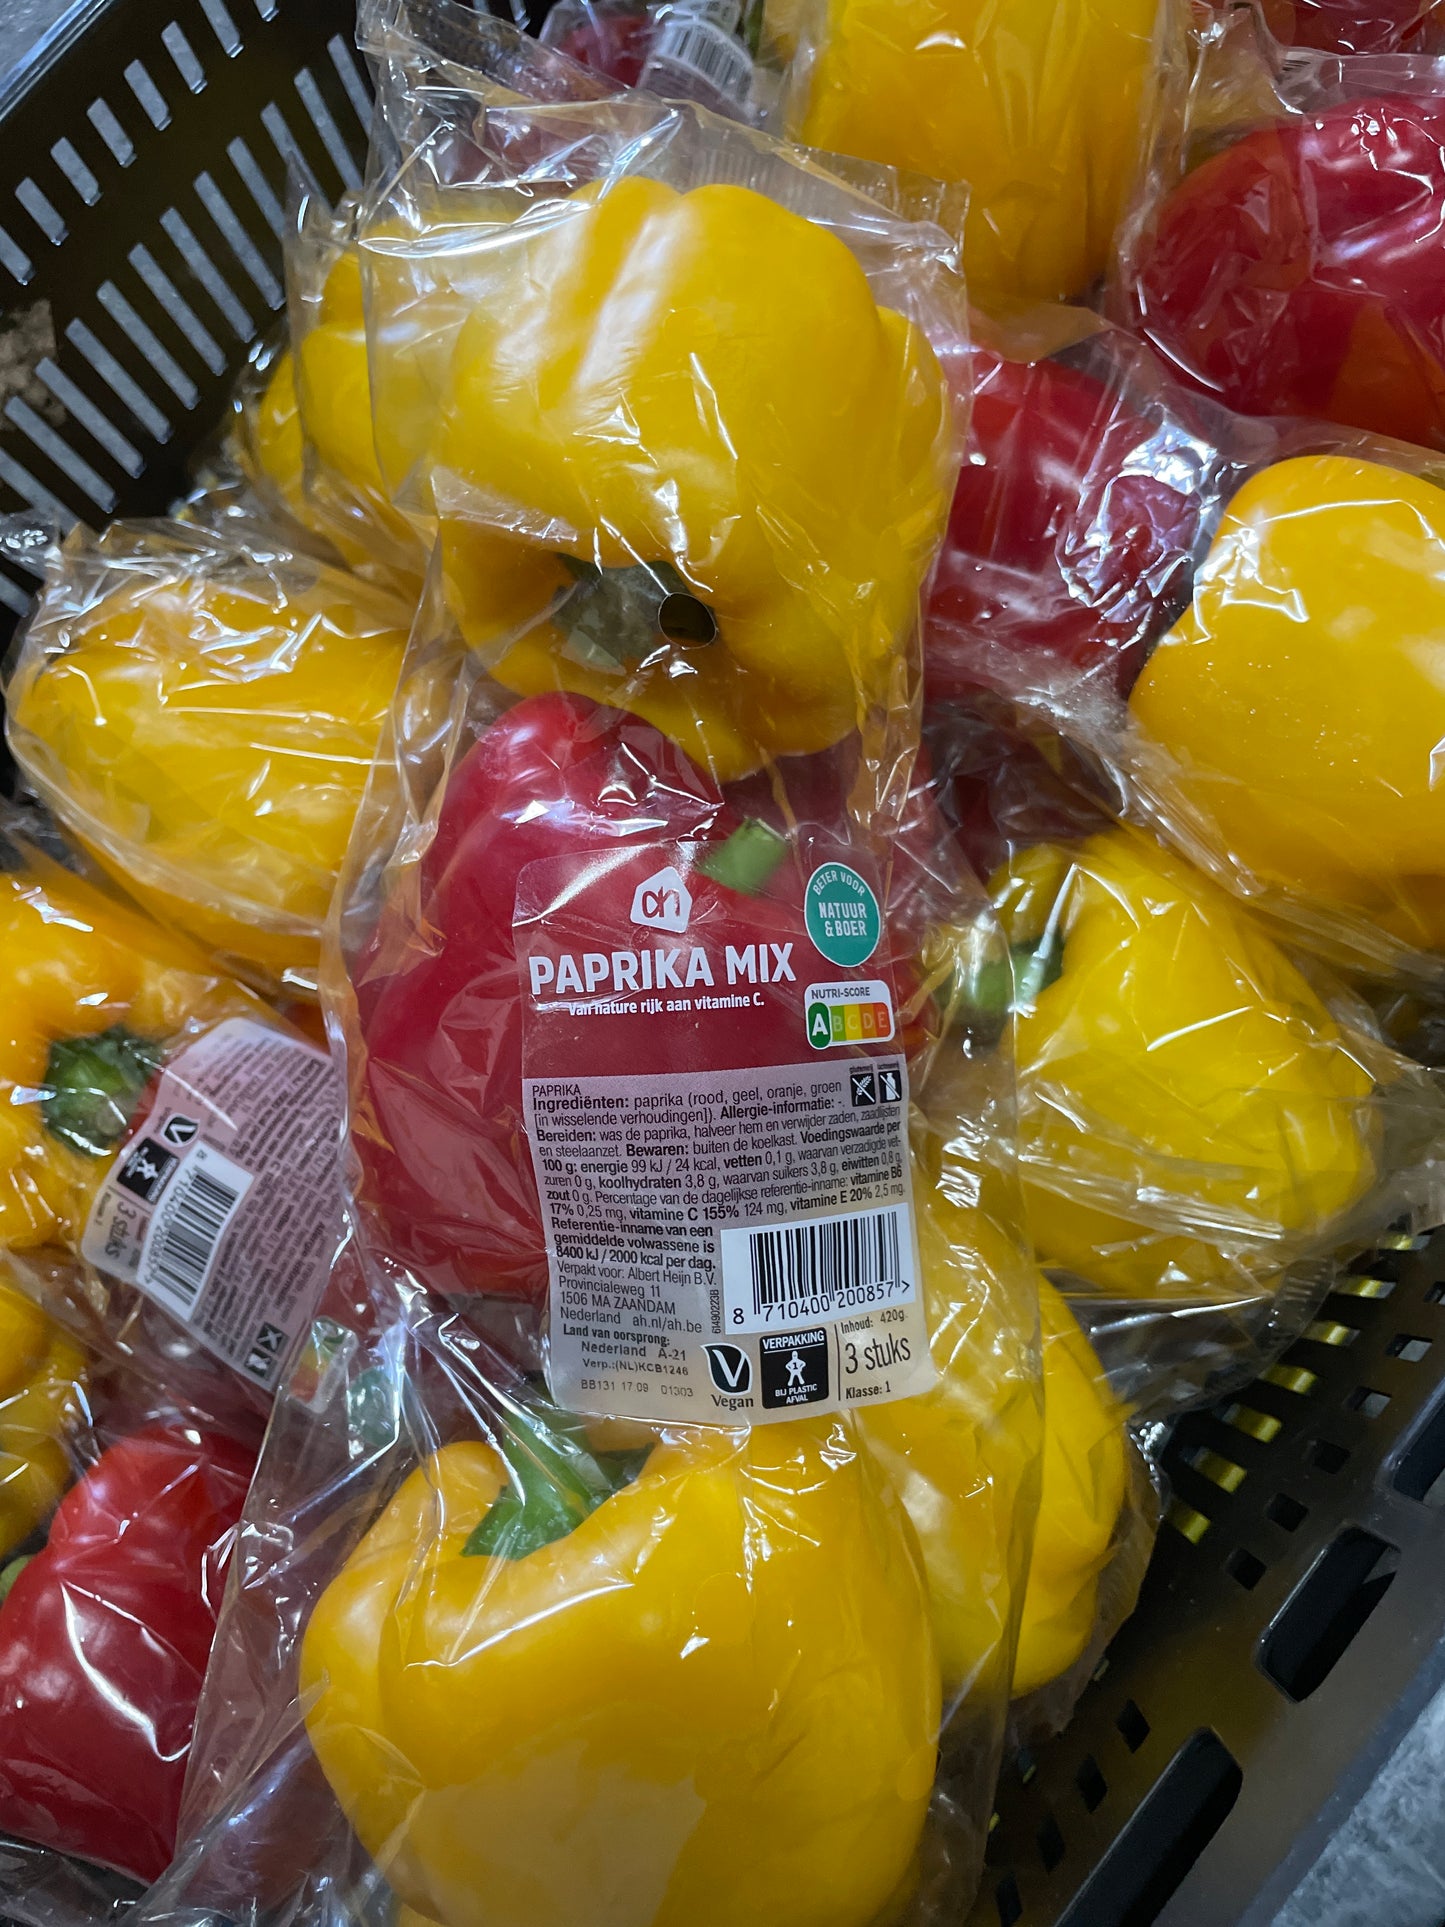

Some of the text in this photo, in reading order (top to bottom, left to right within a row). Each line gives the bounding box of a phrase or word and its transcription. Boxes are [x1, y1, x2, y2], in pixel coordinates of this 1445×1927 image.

[813, 870, 866, 897] BETER VOOR
[819, 902, 867, 918] NATUUR
[529, 943, 796, 995] PAPRIKA MIX
[595, 1001, 637, 1014] nature
[641, 998, 663, 1014] rijk
[666, 999, 692, 1012] aan
[696, 994, 750, 1011] vitamine
[753, 992, 764, 1006] C.
[812, 986, 870, 999] NUTRI-SCORE
[812, 1012, 888, 1036] A B C D E
[532, 1084, 581, 1096] PAPRIKA
[533, 1081, 842, 1112] Ingrediënten: paprika (rood, geel, oranje, groen
[534, 1099, 834, 1129] [in wisselende verhoudingen]). Allergie-informatie:
[536, 1106, 900, 1143] Bereiden: was de paprika, halveer hem en verwijder zaden, zaadlijsten
[539, 1121, 901, 1158] en steelaanzet. Bewaren: buiten de koelkast. Voedingswaarde per
[543, 1159, 562, 1172] 100
[565, 1162, 578, 1174] g:
[580, 1162, 628, 1176] energie
[632, 1160, 646, 1172] 99
[650, 1158, 663, 1172] kJ
[666, 1158, 672, 1176] /
[675, 1158, 690, 1172] 24
[693, 1156, 721, 1172] kcal,
[724, 1154, 762, 1168] vetten
[766, 1151, 782, 1167] 0,1
[798, 1145, 838, 1162] waarvan
[840, 1139, 887, 1156] verzadigde
[888, 1136, 902, 1148] vet-
[544, 1174, 572, 1187] zuren
[574, 1176, 582, 1188] 0
[585, 1178, 596, 1190] g,
[598, 1175, 682, 1192] koolhydraten
[684, 1174, 704, 1190] 3,8
[708, 1177, 720, 1190] g,
[723, 1170, 770, 1186] waarvan
[772, 1165, 809, 1180] suikers
[810, 1160, 828, 1176] 3,8
[842, 1154, 880, 1172] eiwitten
[880, 1152, 894, 1167] 0,8
[547, 1165, 902, 1208] zout 0 g. Percentage van de dagelijkse referentie-inname: vitamine B6
[550, 1204, 574, 1216] 17%
[576, 1203, 600, 1219] 0,25
[605, 1206, 626, 1222] mg,
[629, 1206, 684, 1220] vitamine
[687, 1208, 698, 1220] C
[702, 1204, 740, 1220] 155%
[744, 1202, 763, 1216] 124
[766, 1201, 788, 1216] mg,
[790, 1194, 838, 1211] vitamine
[840, 1192, 848, 1204] E
[850, 1186, 873, 1202] 20%
[874, 1184, 888, 1200] 2,5
[551, 1216, 714, 1237] Referentie-inname van een
[554, 1232, 715, 1254] gemiddelde volwassene is
[556, 1246, 716, 1273] 8400 kJ / 2000 kcal per dag.
[556, 1260, 718, 1287] Verpakt voor: Albert Heijn B.V.
[558, 1276, 661, 1299] Provincialeweg 11
[560, 1292, 676, 1315] 1506 MA ZAANDAM
[732, 1281, 894, 1325] 8 710400 200857
[560, 1307, 702, 1333] Nederland ah.nl/ah.be
[841, 1316, 874, 1334] Inhoud:
[563, 1324, 670, 1348] Land van oorsprong:
[762, 1330, 825, 1350] VERPAKKING
[582, 1341, 686, 1362] Nederland A-21
[844, 1332, 912, 1374] 3 stuks
[792, 1362, 798, 1370] 1
[581, 1379, 615, 1392] BB131
[660, 1384, 694, 1397] 01303
[786, 1394, 809, 1404] AFVAL
[788, 1384, 818, 1396] PLASTIC
[846, 1380, 892, 1400] Klasse: 1
[711, 1394, 754, 1412] Vegan
